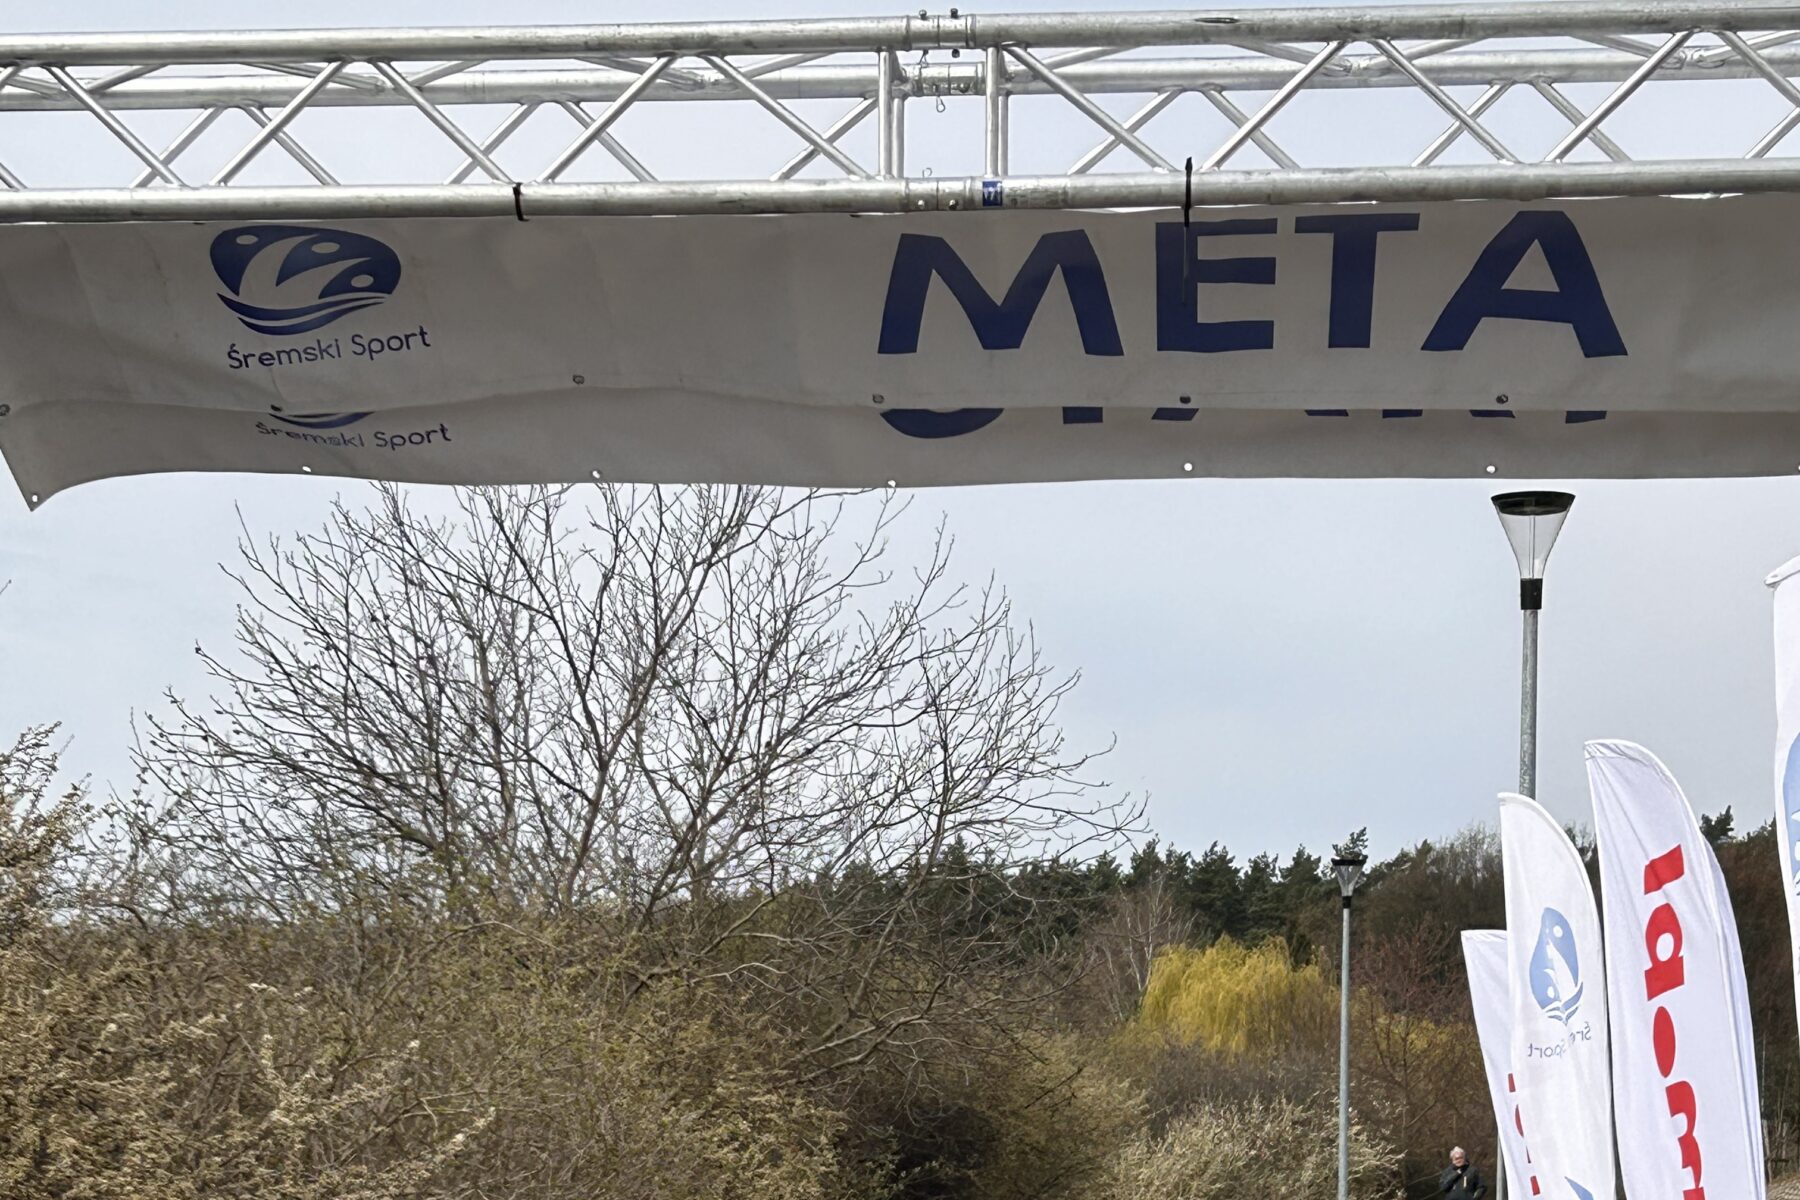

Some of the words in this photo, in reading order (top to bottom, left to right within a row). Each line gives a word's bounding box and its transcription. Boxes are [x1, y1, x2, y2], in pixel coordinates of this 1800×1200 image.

[878, 210, 1627, 357] META
[228, 338, 342, 369] Śremski
[351, 325, 431, 361] Sport
[373, 423, 452, 451] Sport
